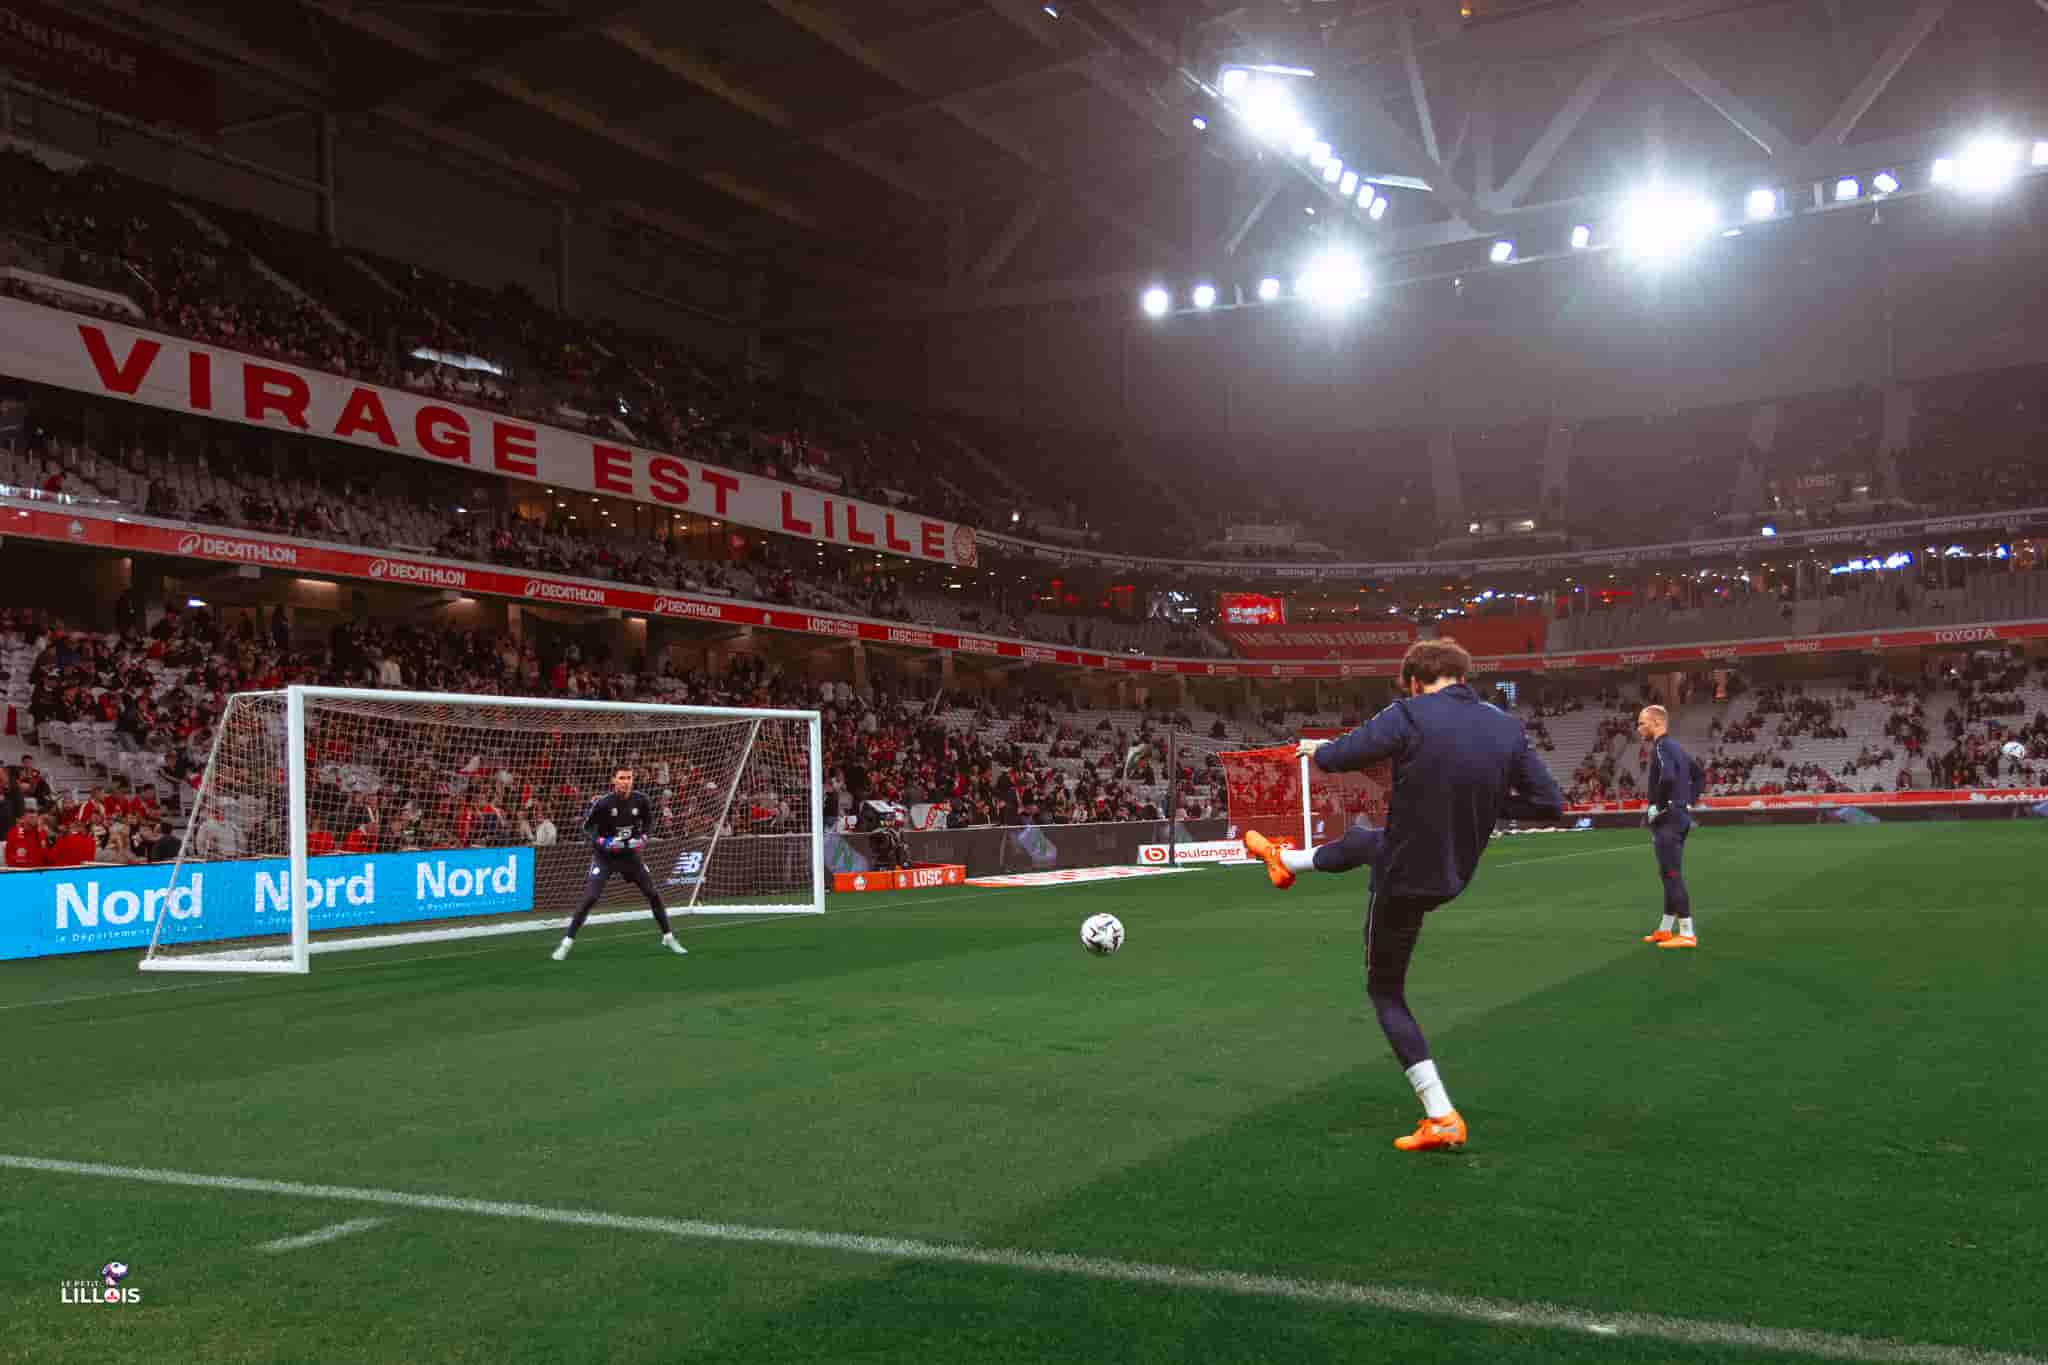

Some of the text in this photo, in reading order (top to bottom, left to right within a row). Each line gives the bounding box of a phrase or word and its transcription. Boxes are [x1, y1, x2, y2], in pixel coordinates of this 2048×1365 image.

[78, 323, 945, 560] VIRAGE EST LILLE
[202, 540, 297, 565] DECATHLON
[389, 562, 466, 585] DECATHLON
[541, 582, 605, 603] DECATHLON
[668, 600, 721, 618] DECATHLON
[1935, 628, 1996, 642] TOYOTA
[255, 863, 375, 912] Nord
[416, 854, 517, 900] Nord
[913, 870, 943, 888] LOSC
[55, 872, 204, 929] Nord
